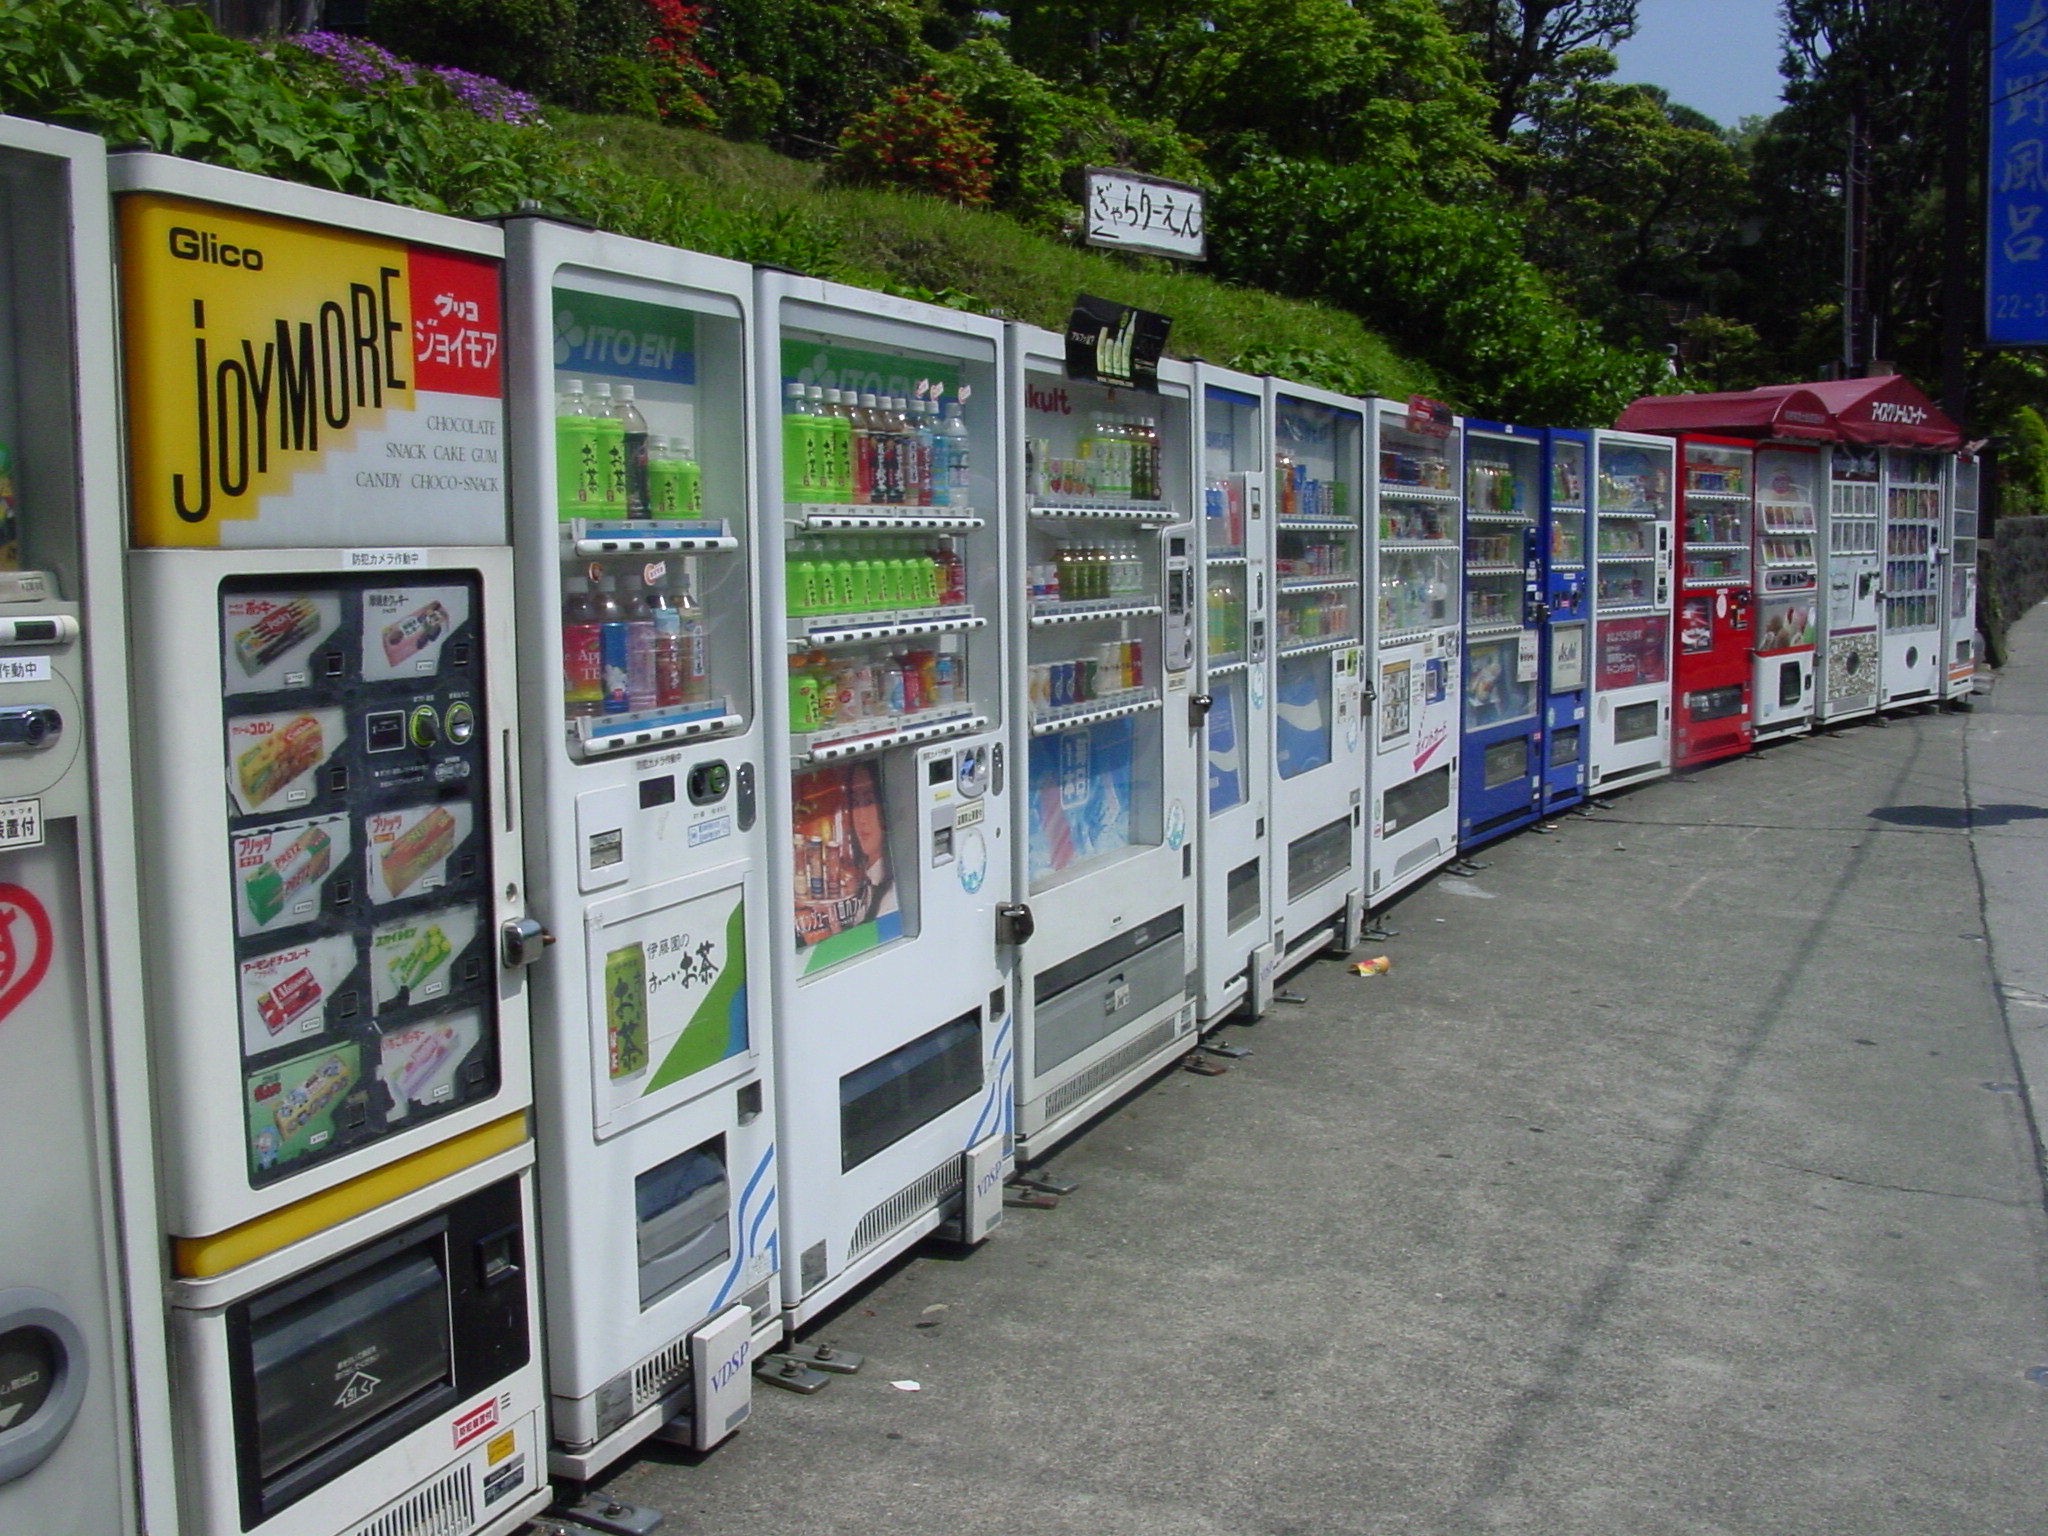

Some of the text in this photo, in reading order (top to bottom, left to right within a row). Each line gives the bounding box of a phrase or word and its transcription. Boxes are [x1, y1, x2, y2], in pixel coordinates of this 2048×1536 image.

[169, 227, 263, 271] Glico
[434, 292, 479, 323] グリコ
[415, 319, 498, 368] ジョイモア
[585, 324, 677, 370] ITO EN
[1025, 383, 1072, 415] kult
[426, 415, 497, 436] CHOCOLATE
[385, 442, 498, 464] SNACK CAKE GUM
[355, 471, 499, 492] CANDY CHOCO-SNACK
[977, 1160, 1002, 1198] VDSP
[711, 1340, 750, 1394] VDSP
